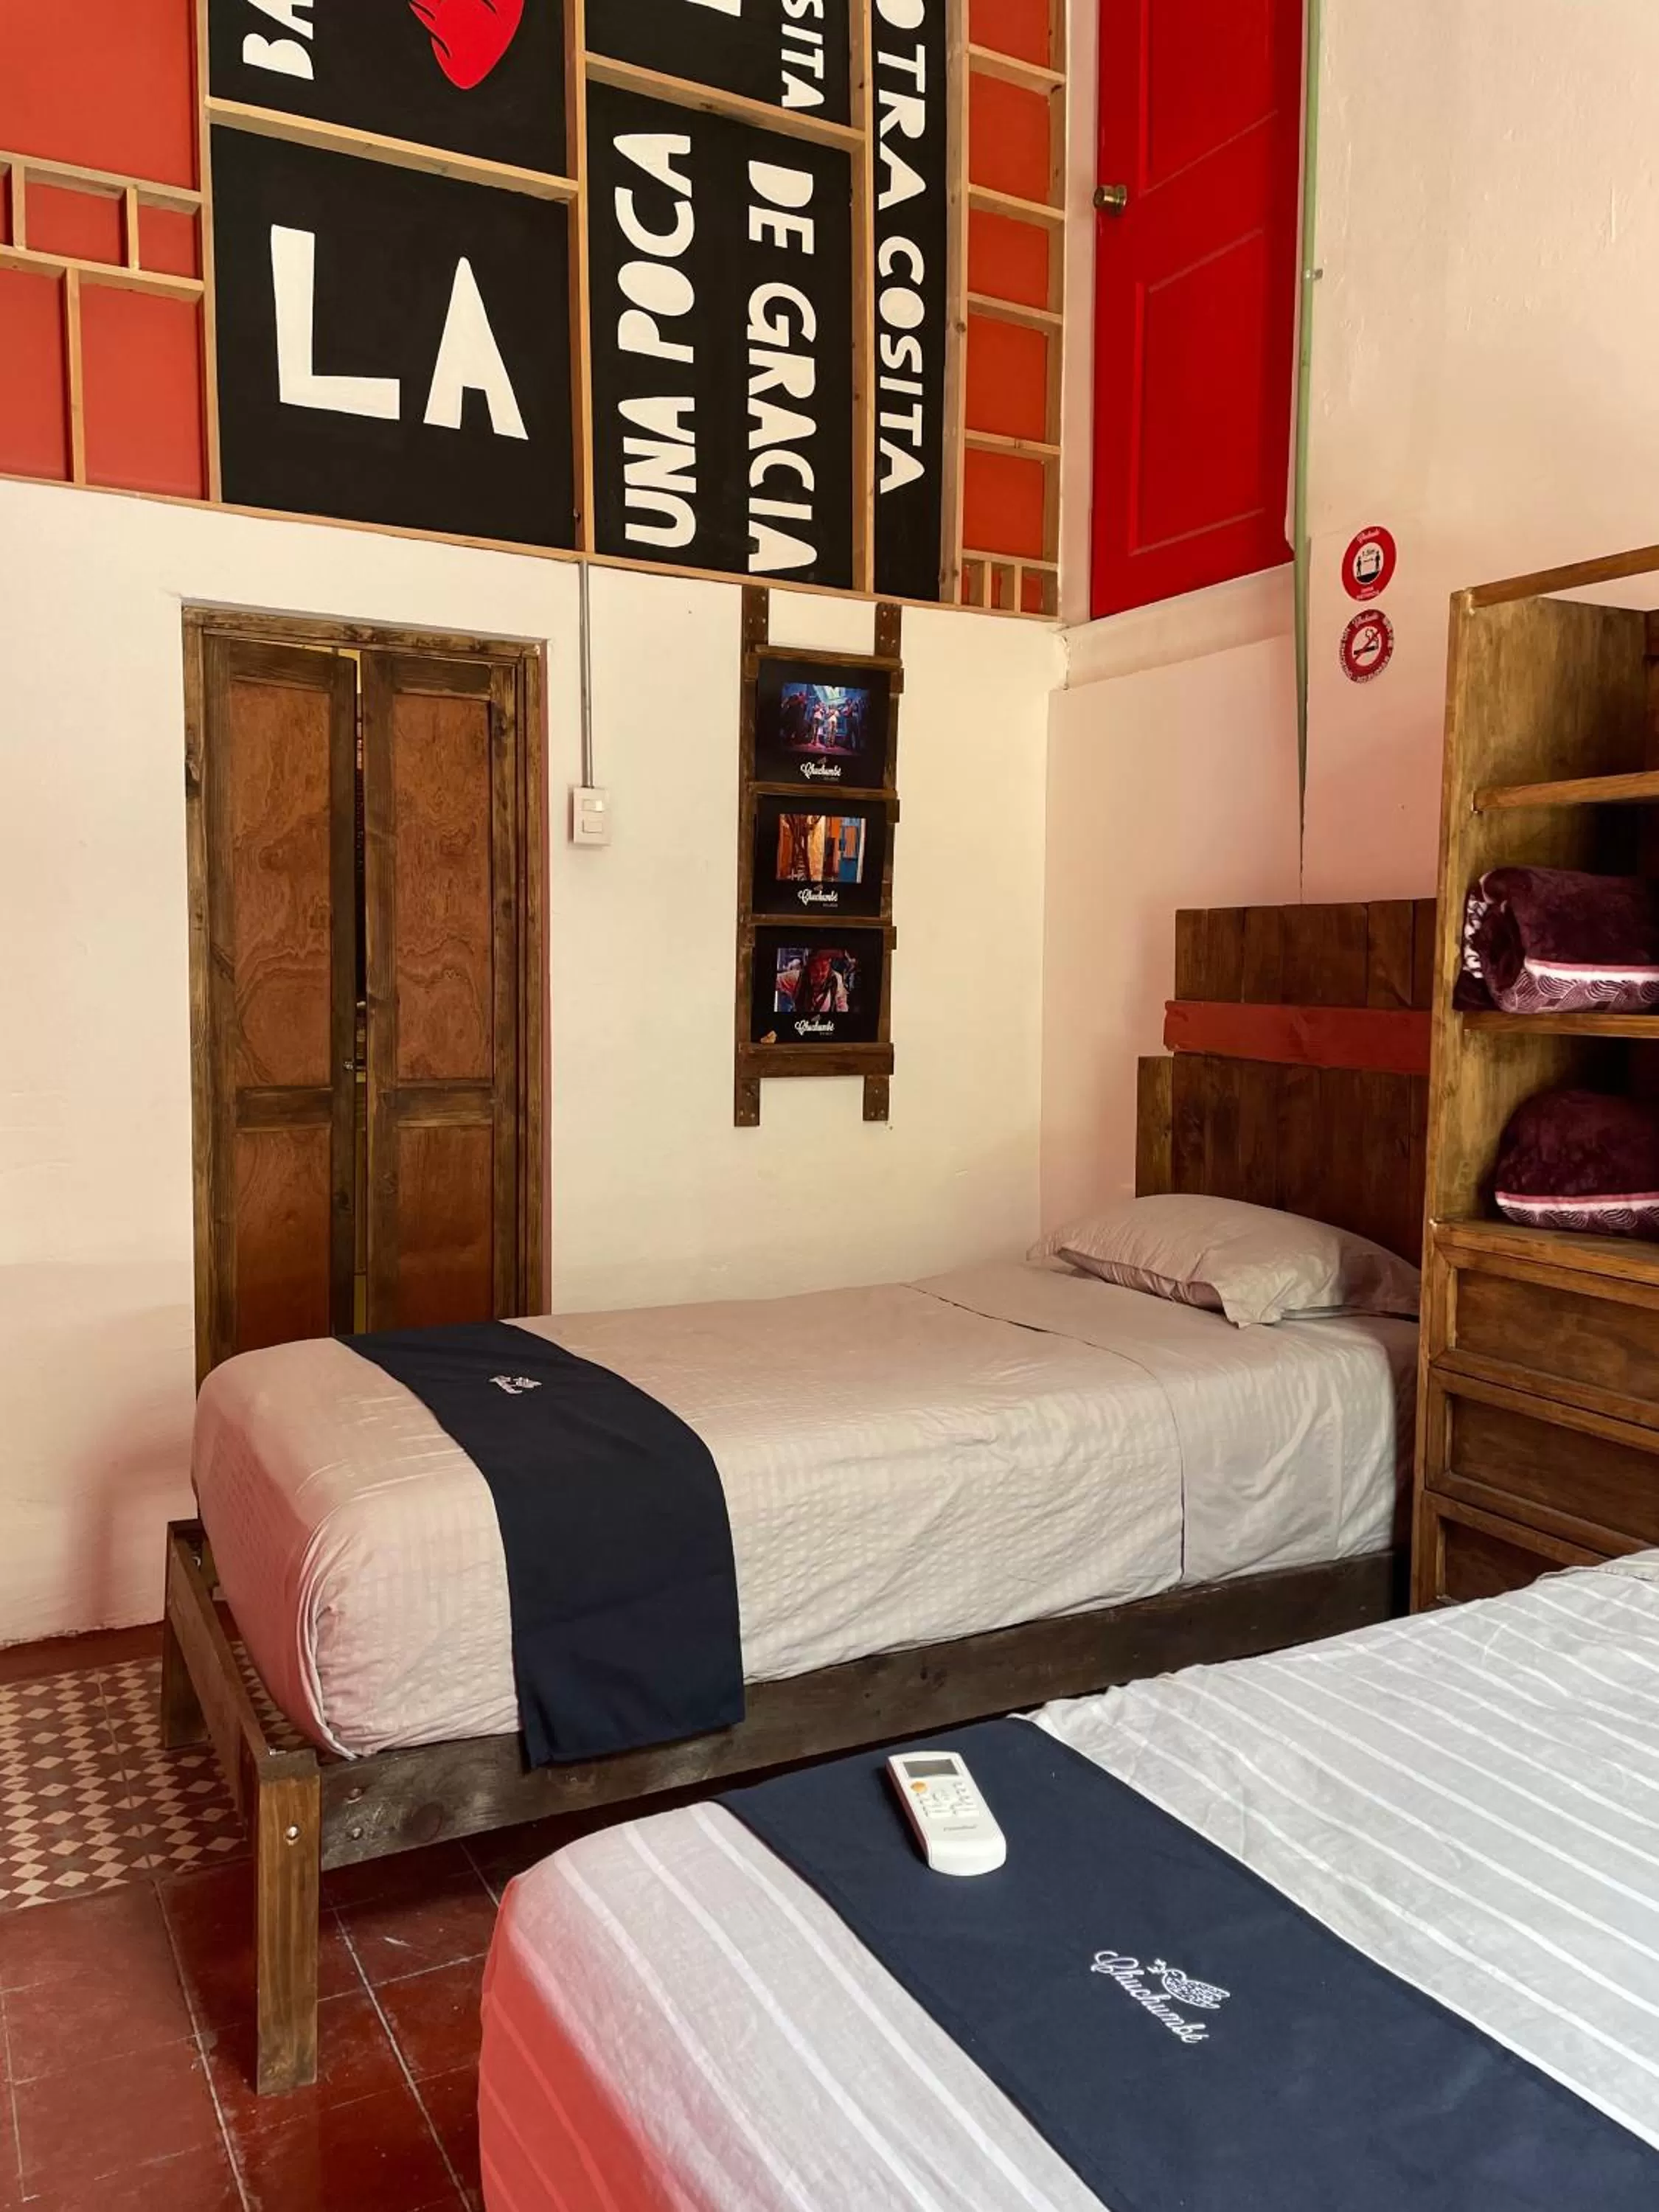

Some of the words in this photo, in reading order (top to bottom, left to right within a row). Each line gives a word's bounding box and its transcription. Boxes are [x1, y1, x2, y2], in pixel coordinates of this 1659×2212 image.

[613, 133, 695, 364] POCA
[748, 160, 814, 254] DE
[271, 223, 529, 440] LA
[747, 282, 818, 573] GRACIA
[878, 236, 925, 494] COSITA
[618, 397, 697, 548] UNA
